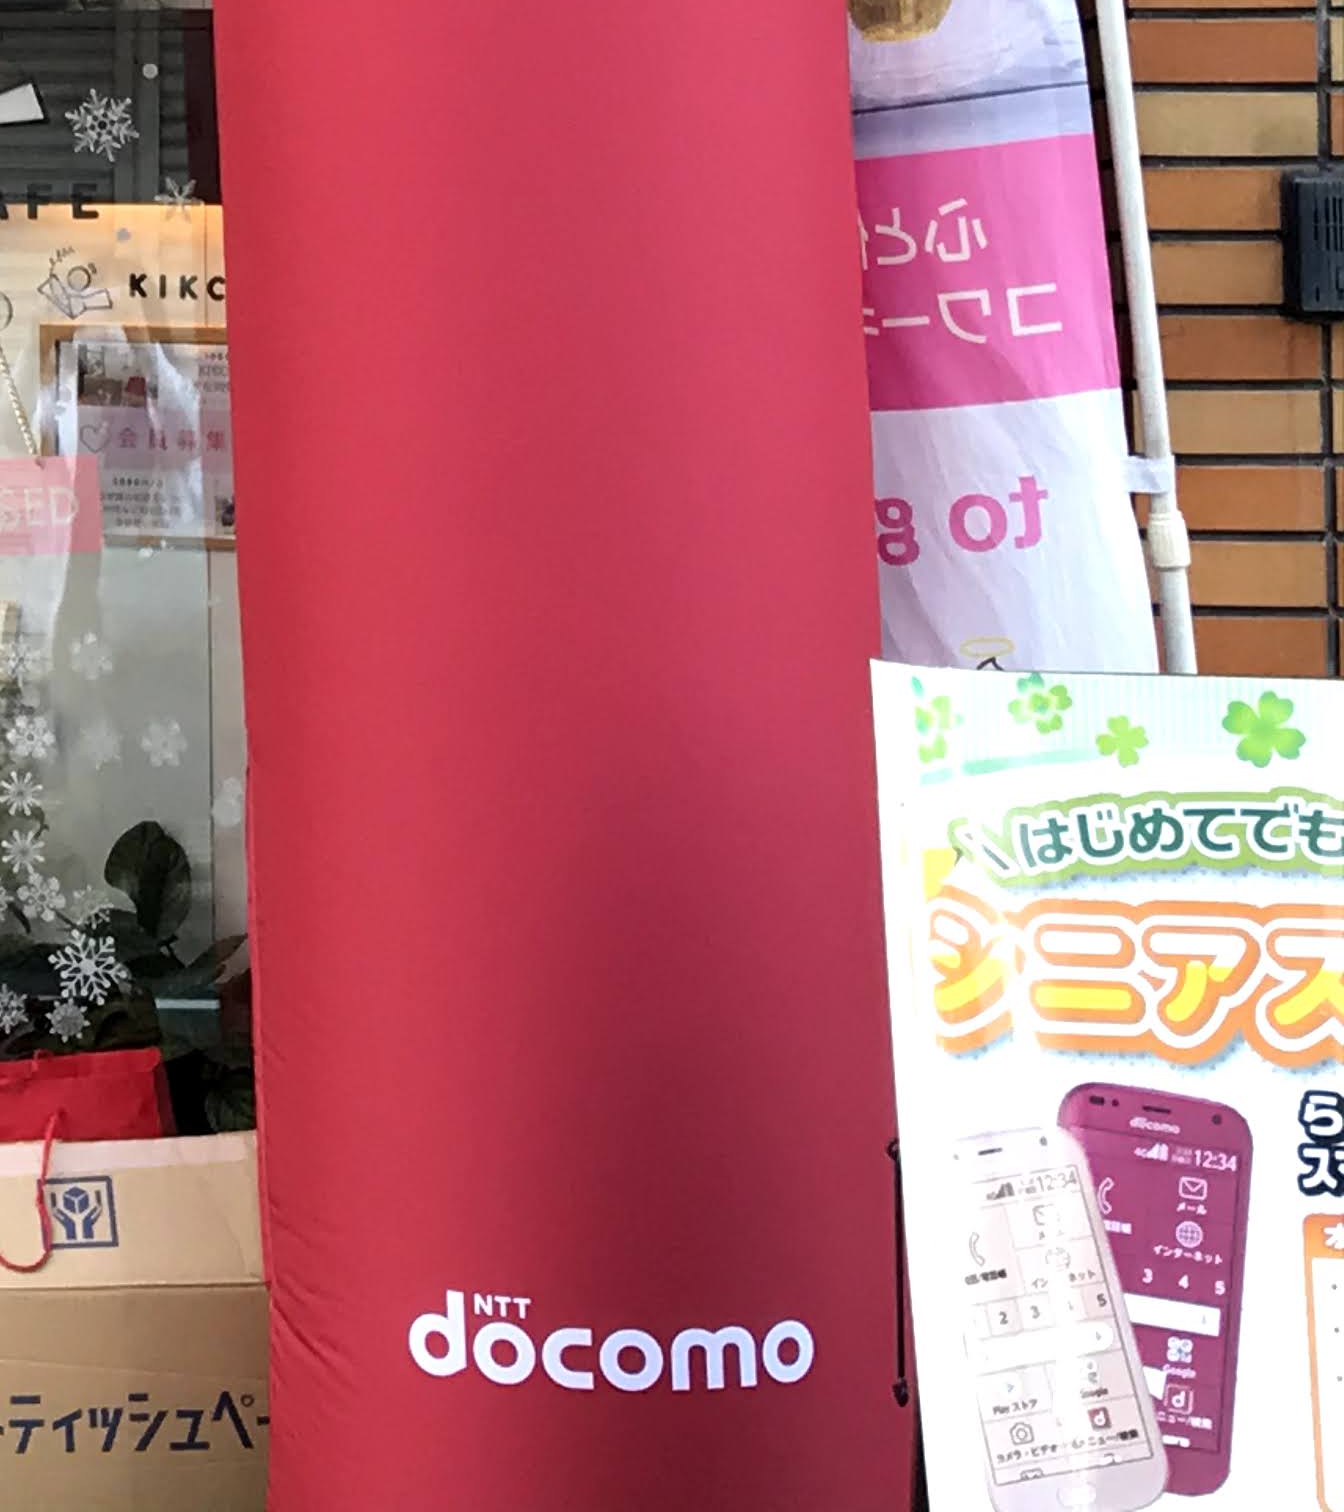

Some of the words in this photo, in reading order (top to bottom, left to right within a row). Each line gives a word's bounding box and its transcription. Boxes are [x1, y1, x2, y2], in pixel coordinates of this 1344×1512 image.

[1018, 803, 1344, 869] はじめてでも
[1193, 1148, 1238, 1173] 12:34
[1141, 1268, 1154, 1284] 3
[1178, 1274, 1190, 1289] 4
[1214, 1280, 1227, 1296] 5
[473, 1292, 532, 1320] NTT
[998, 1311, 1009, 1326] 2
[1030, 1305, 1041, 1320] 3
[1096, 1292, 1108, 1308] 5
[408, 1289, 815, 1392] docomo
